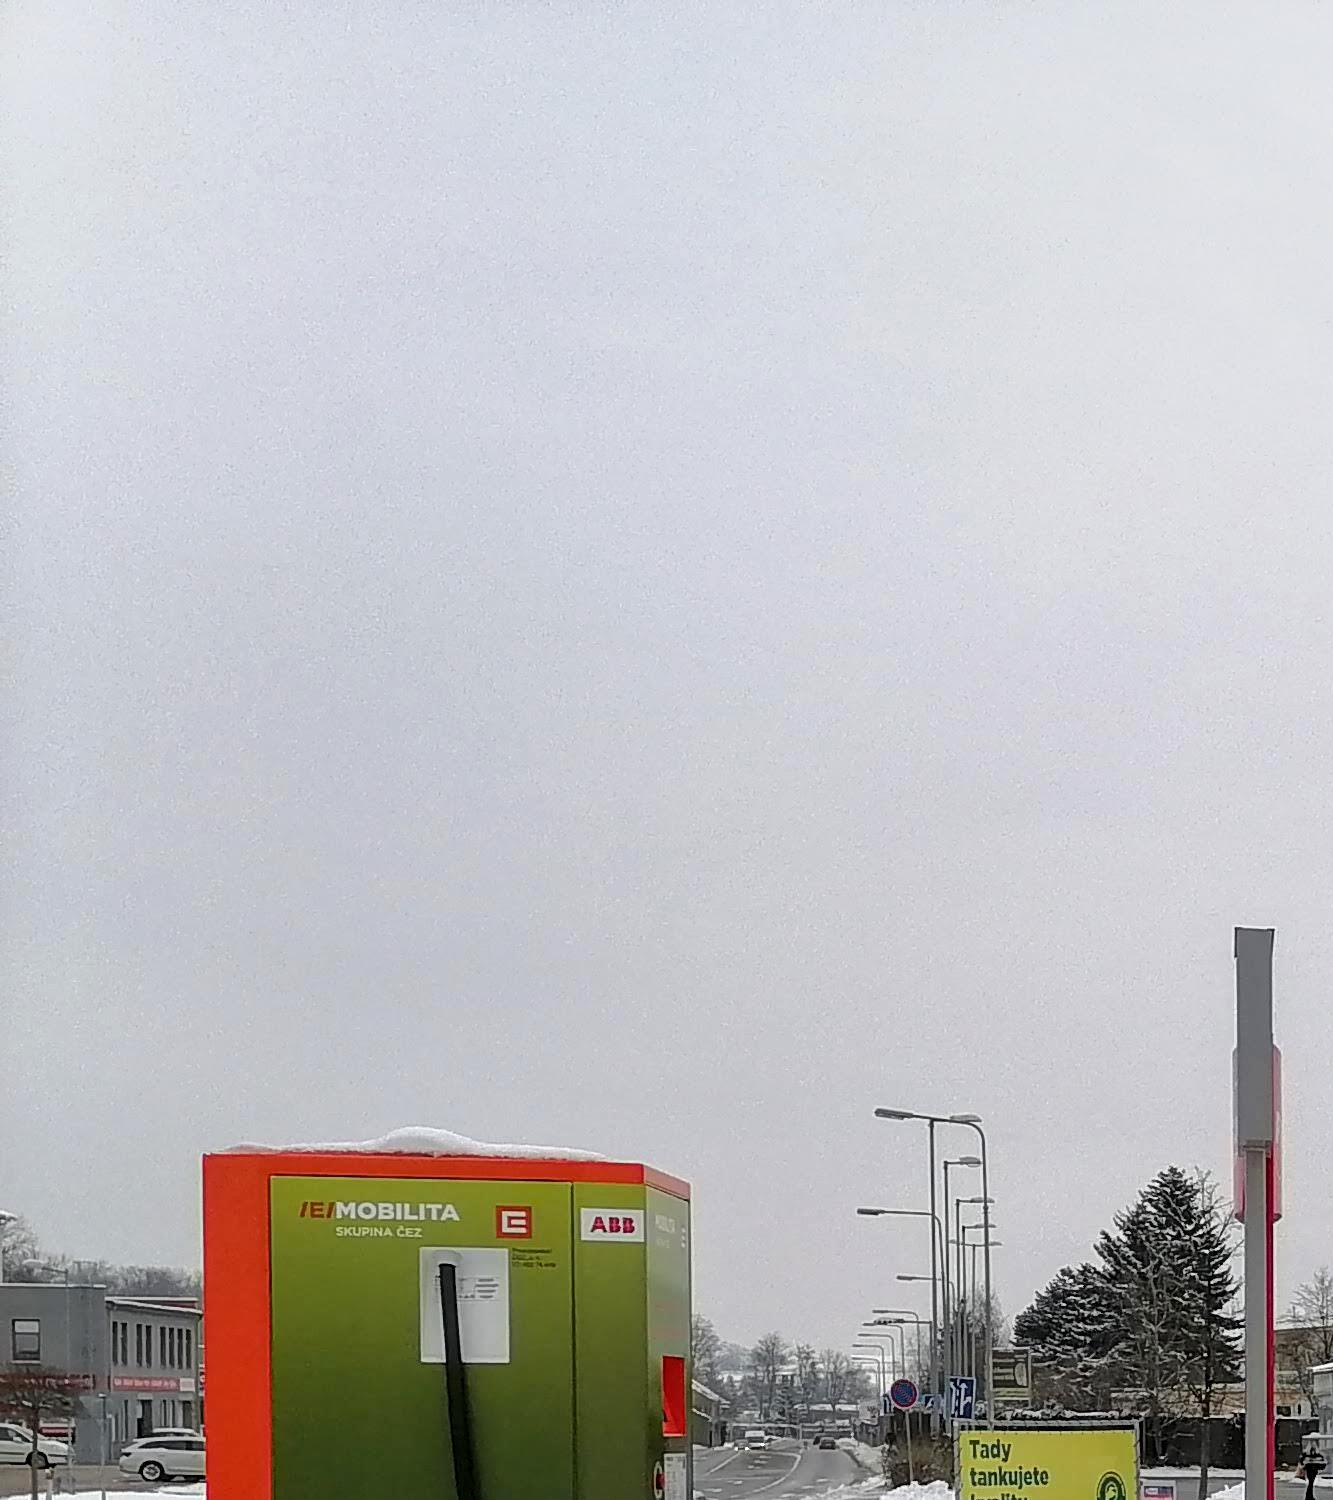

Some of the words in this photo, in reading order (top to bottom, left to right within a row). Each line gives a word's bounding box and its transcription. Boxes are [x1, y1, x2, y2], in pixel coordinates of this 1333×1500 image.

[336, 1226, 393, 1237] SKUPINA
[397, 1225, 423, 1238] ČEZ
[590, 1216, 635, 1234] ABB
[969, 1439, 1011, 1462] Tady
[970, 1466, 1049, 1490] tankujete
